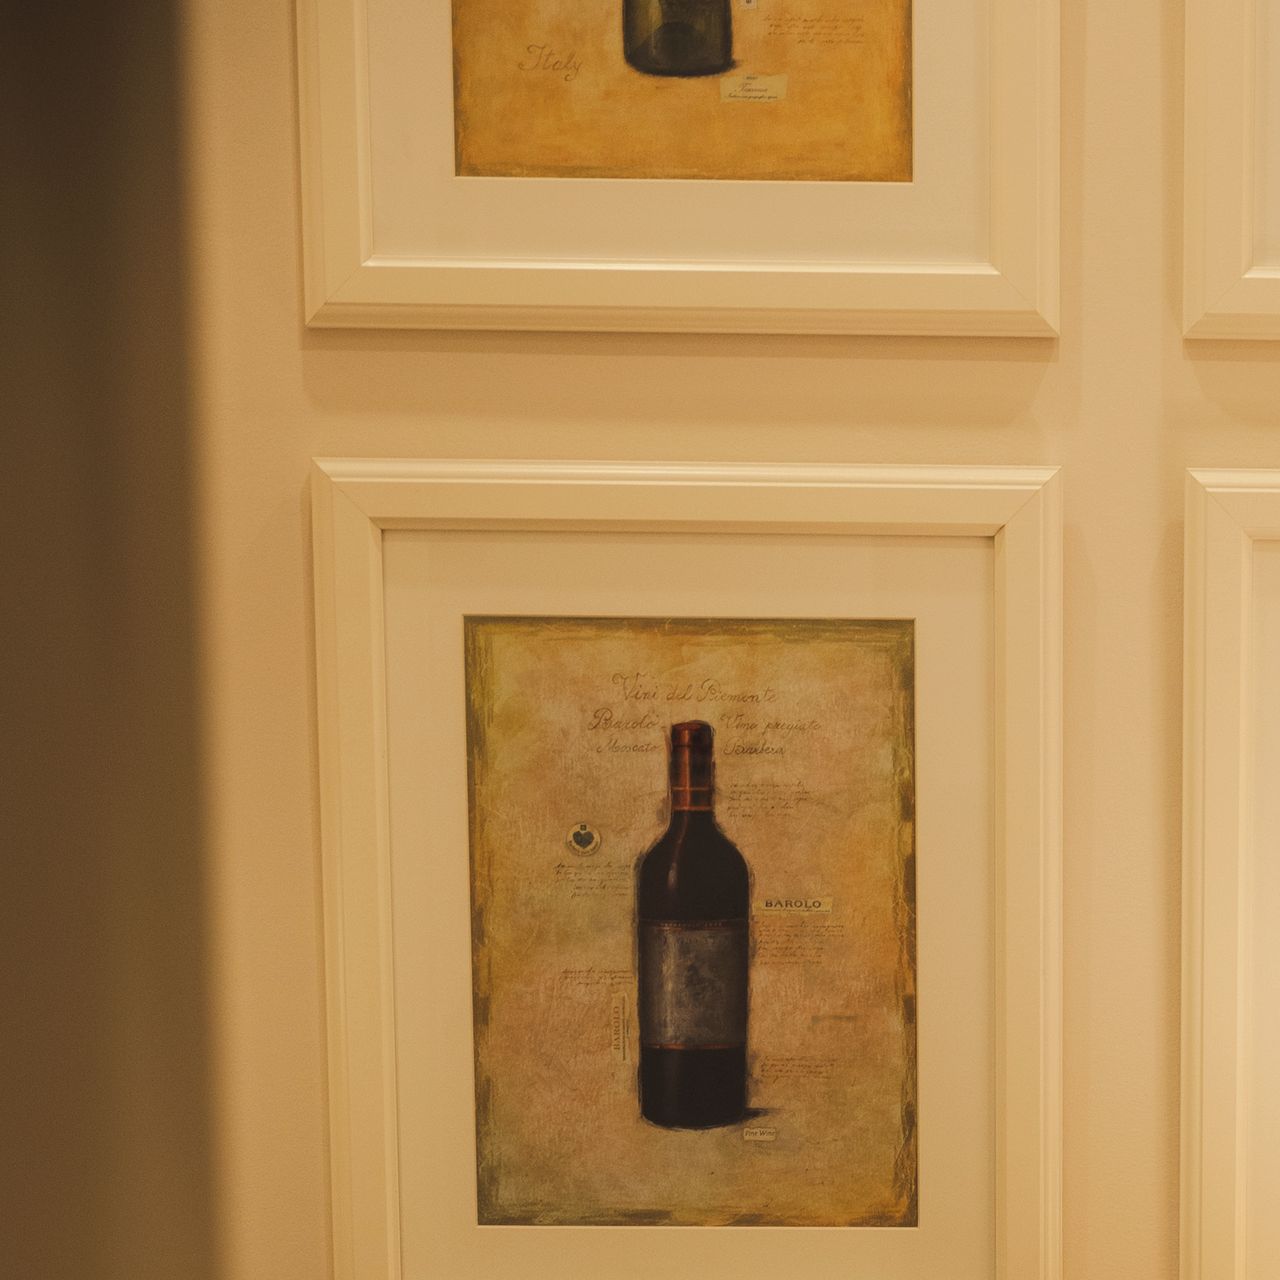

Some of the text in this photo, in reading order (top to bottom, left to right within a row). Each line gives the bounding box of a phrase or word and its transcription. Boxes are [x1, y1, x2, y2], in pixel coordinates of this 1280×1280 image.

[518, 44, 583, 82] Italy
[612, 672, 657, 700] Vini
[666, 684, 693, 701] del
[765, 900, 822, 909] BAROLO
[613, 1006, 621, 1050] BAROLO
